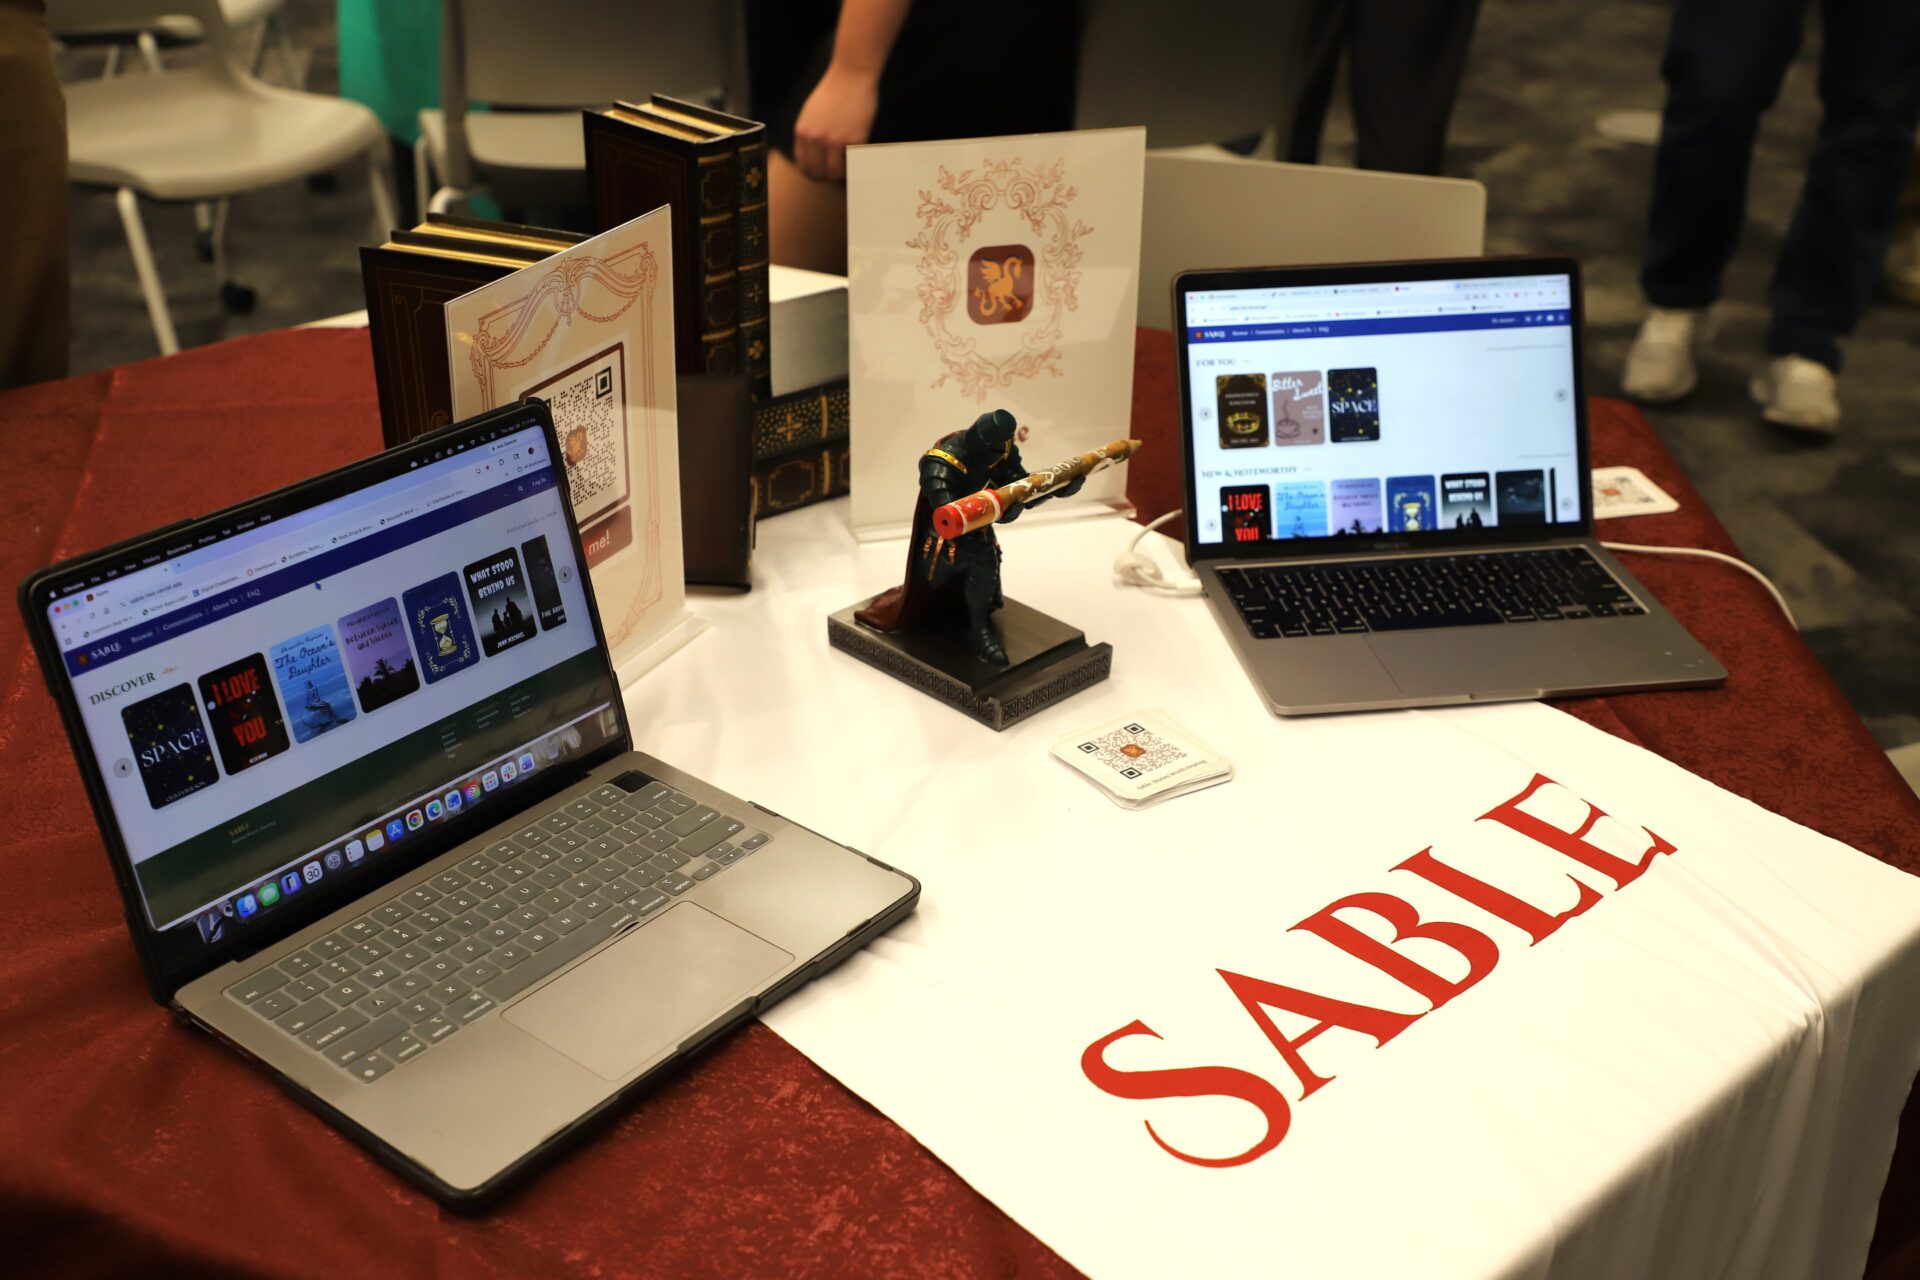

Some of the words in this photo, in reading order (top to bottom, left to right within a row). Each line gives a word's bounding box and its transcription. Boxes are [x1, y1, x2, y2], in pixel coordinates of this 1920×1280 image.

[1236, 493, 1263, 511] LOVE
[588, 529, 610, 557] me!
[469, 567, 491, 584] WHAT
[490, 557, 514, 575] STOOD
[245, 587, 261, 601] FAQ
[477, 578, 505, 599] BEHIND
[504, 574, 515, 587] US
[89, 640, 123, 662] SABLE
[274, 652, 297, 669] The
[297, 634, 336, 660] Ocean's
[286, 652, 332, 681] Daughter
[88, 669, 157, 706] DISCOVER
[212, 683, 221, 705] I
[221, 667, 261, 702] LOVE
[232, 714, 269, 748] YOU
[139, 725, 207, 769] SPACE
[307, 868, 320, 881] 30
[1080, 773, 1678, 1168] SABLE
